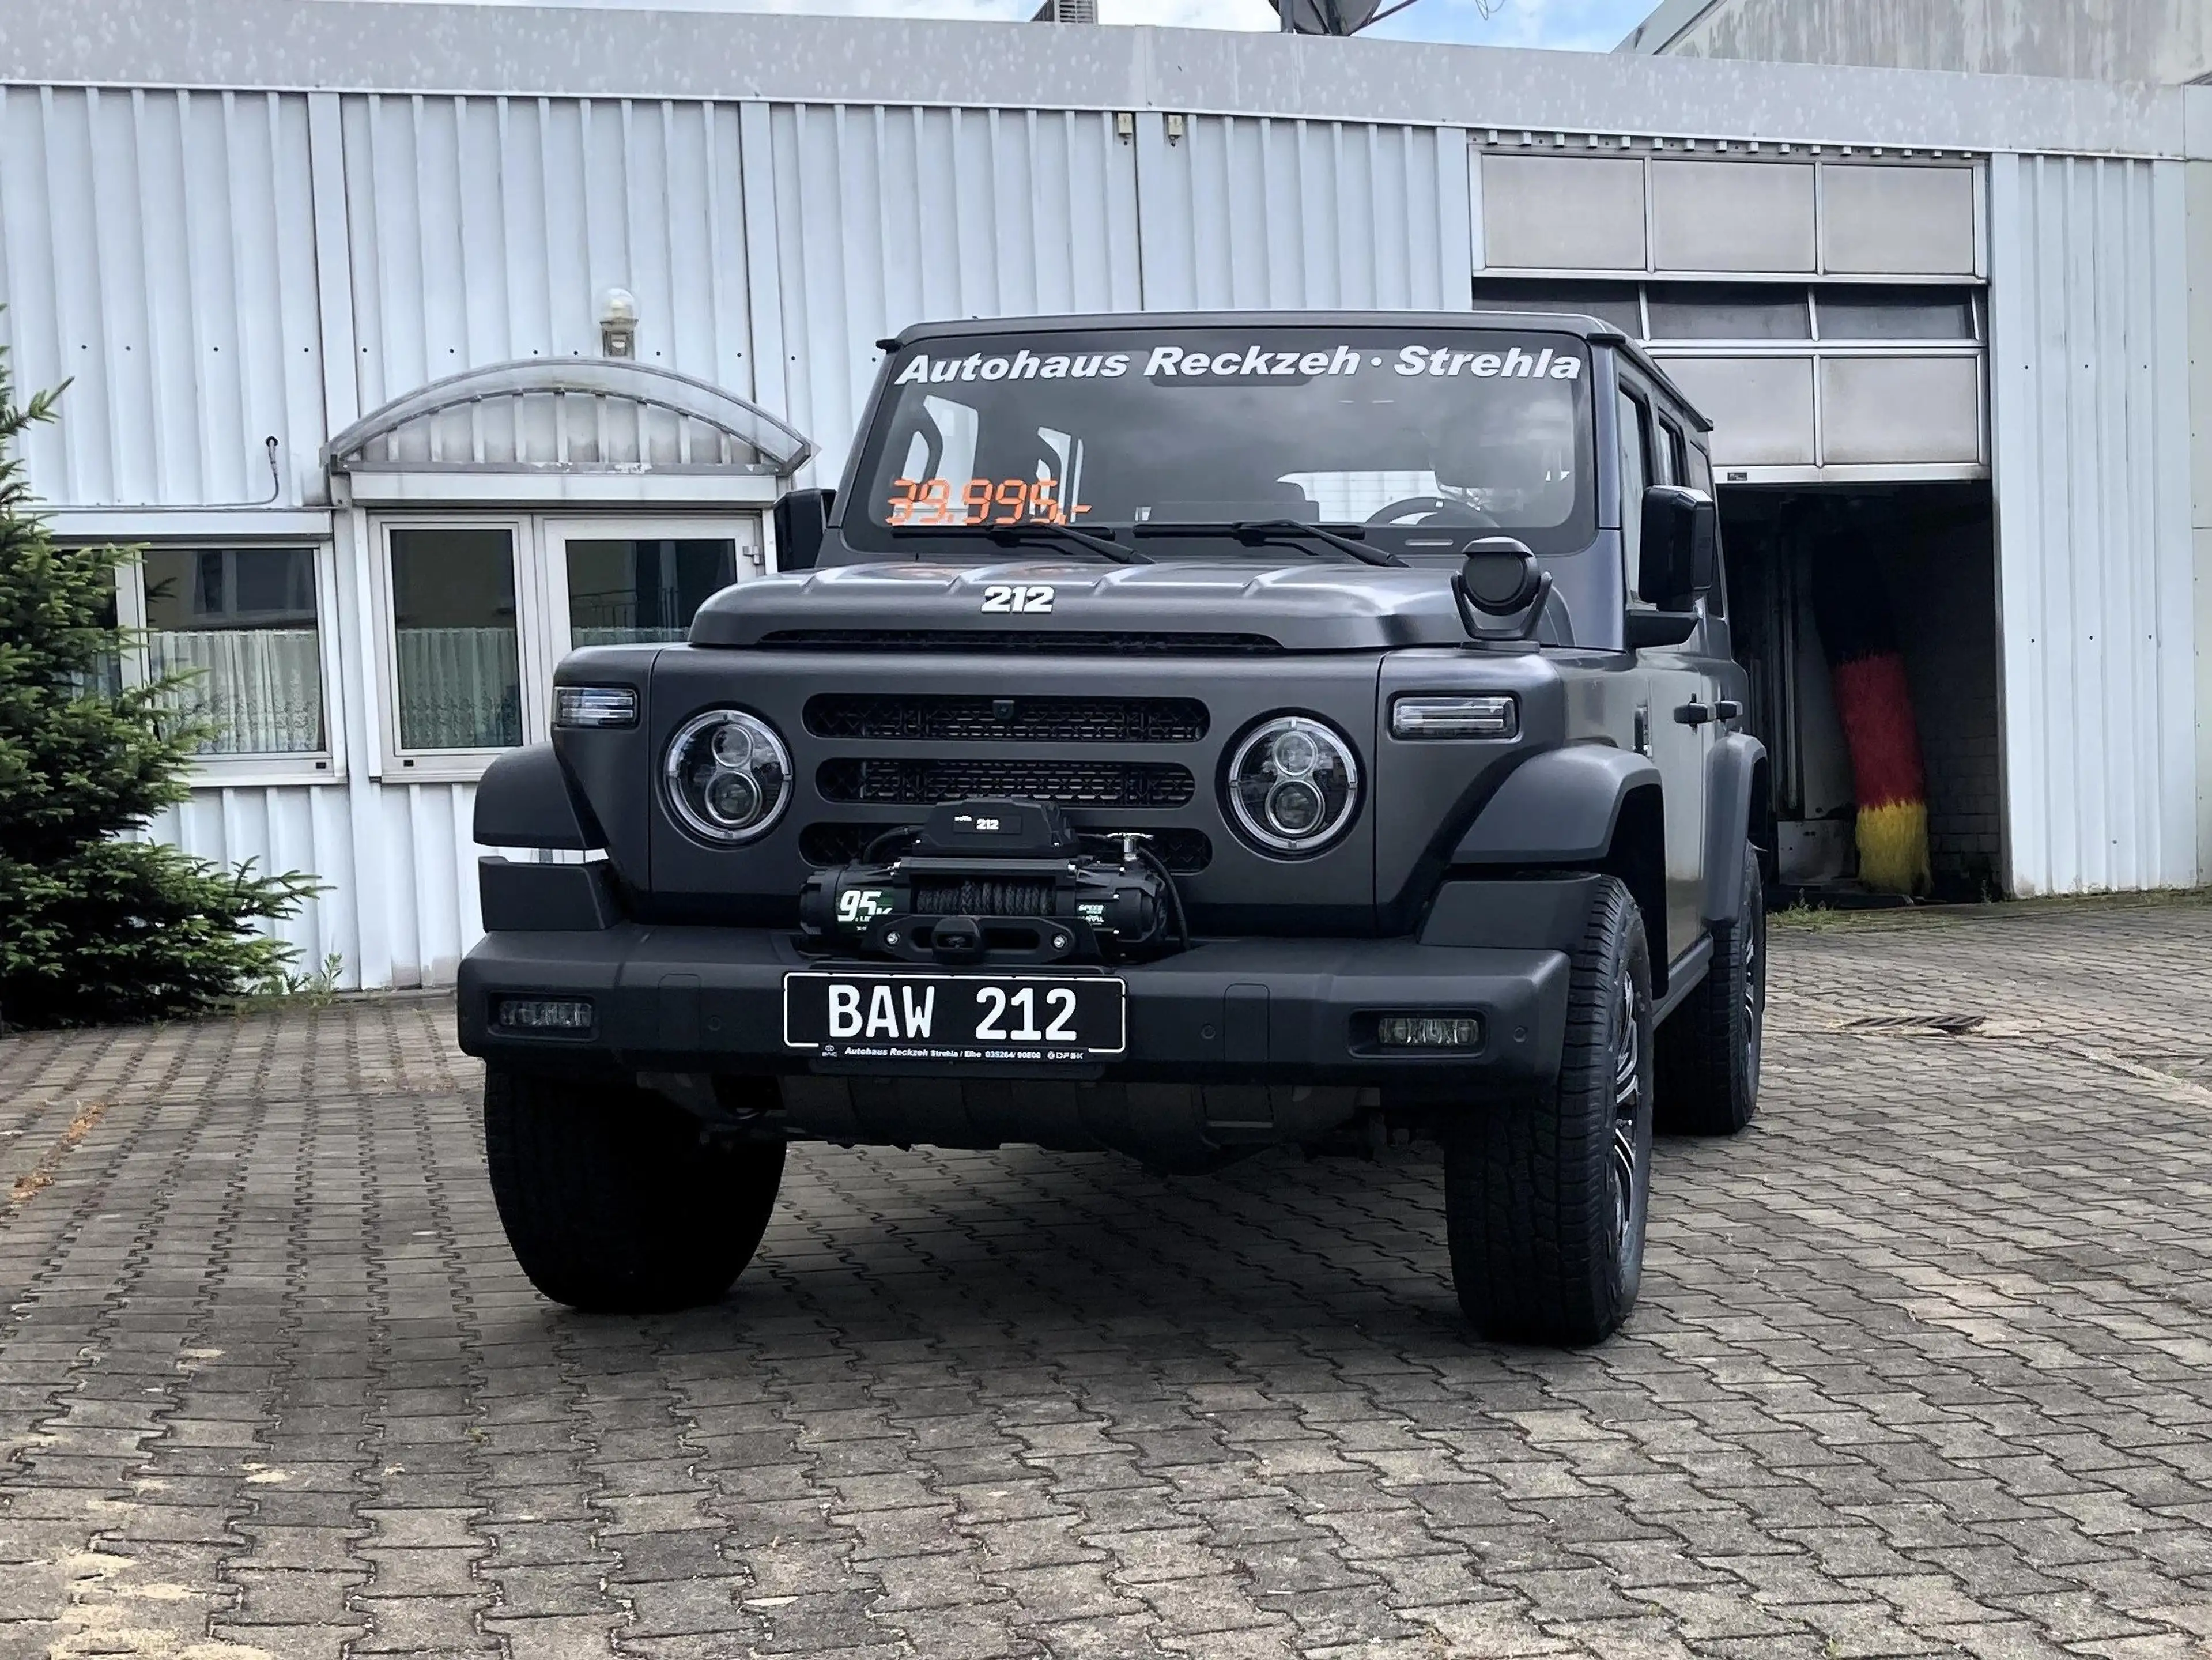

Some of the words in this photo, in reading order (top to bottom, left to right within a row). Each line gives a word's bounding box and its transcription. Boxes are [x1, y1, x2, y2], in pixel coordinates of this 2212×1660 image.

[894, 350, 1130, 384] Autohaus
[1143, 346, 1360, 375] Reckzeh
[1394, 346, 1581, 379] Strehla
[981, 580, 1054, 612] 212
[976, 818, 999, 830] 212
[828, 984, 935, 1038] BAW
[976, 987, 1077, 1041] 212
[844, 1047, 888, 1056] Autohaus
[889, 1048, 928, 1057] Reckzeh
